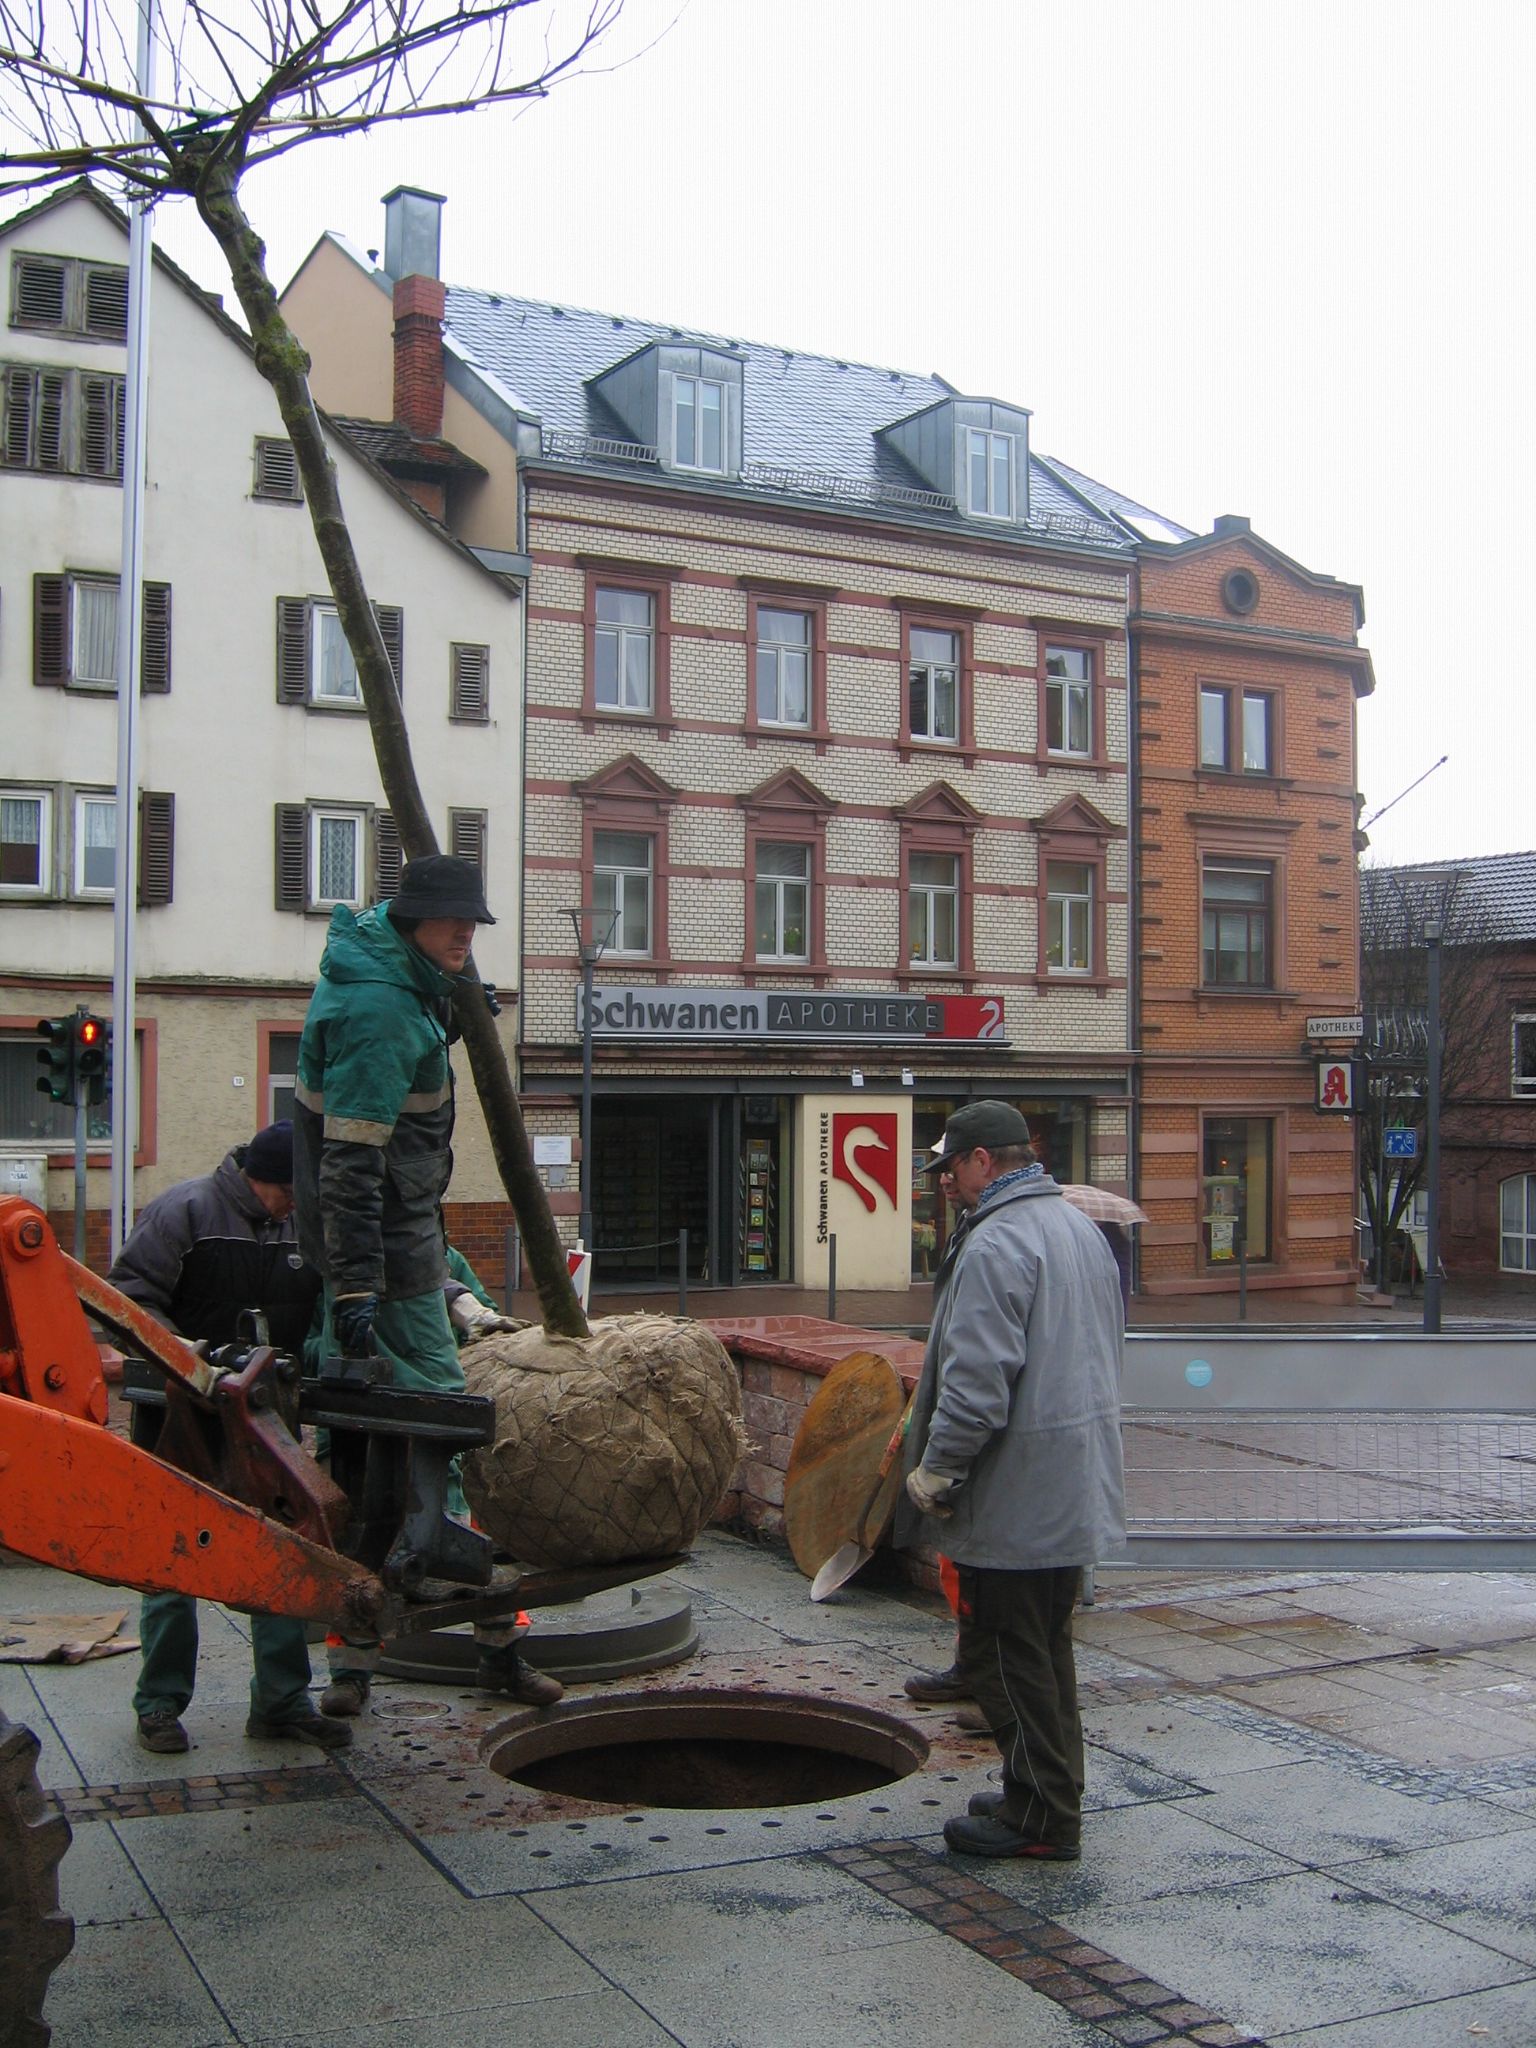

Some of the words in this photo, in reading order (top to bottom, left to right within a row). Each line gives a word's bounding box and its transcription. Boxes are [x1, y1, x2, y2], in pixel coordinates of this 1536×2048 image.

[582, 991, 758, 1030] Schwanen
[776, 1001, 939, 1028] APOTHEKE
[1309, 1022, 1362, 1032] APOTHEKE
[1321, 1066, 1349, 1106] A
[820, 1112, 828, 1174] APOTHEKE
[817, 1180, 828, 1243] Schwanen
